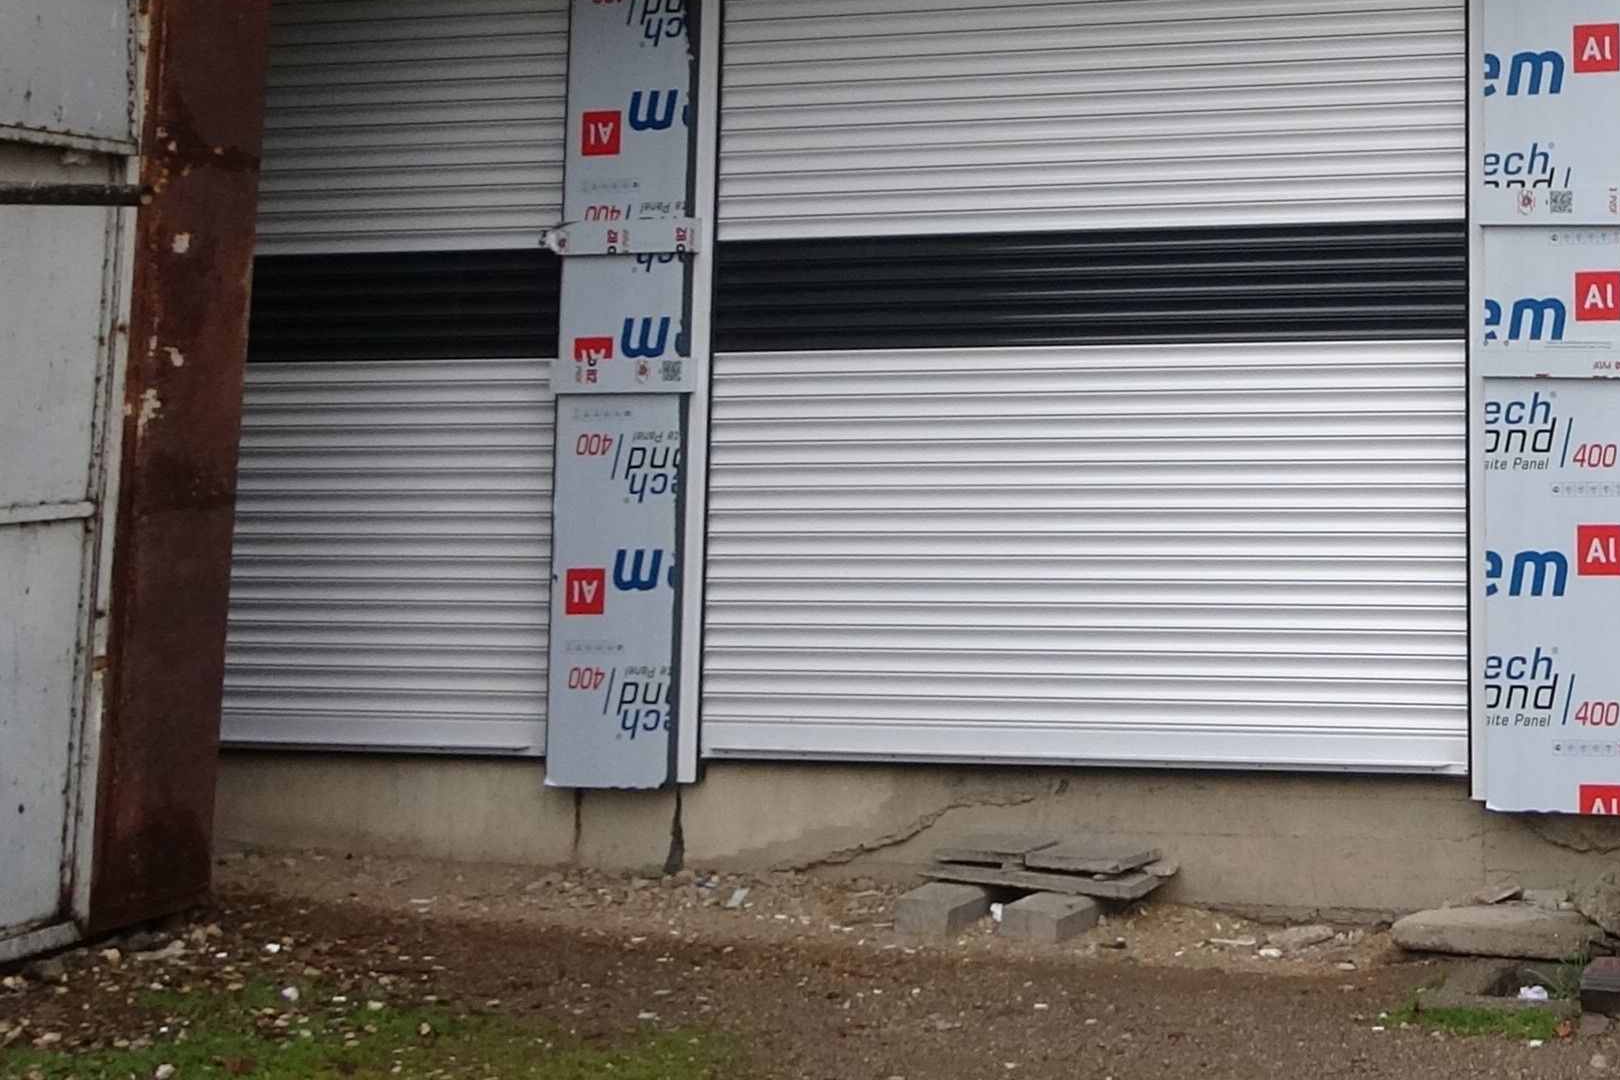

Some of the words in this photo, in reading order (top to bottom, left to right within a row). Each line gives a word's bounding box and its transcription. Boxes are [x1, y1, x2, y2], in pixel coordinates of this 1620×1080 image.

[575, 433, 613, 456] 400
[1572, 443, 1618, 468] 400
[1512, 457, 1550, 470] Panel
[567, 666, 606, 690] 400
[1514, 714, 1552, 728] Panel
[1575, 701, 1620, 726] 400
